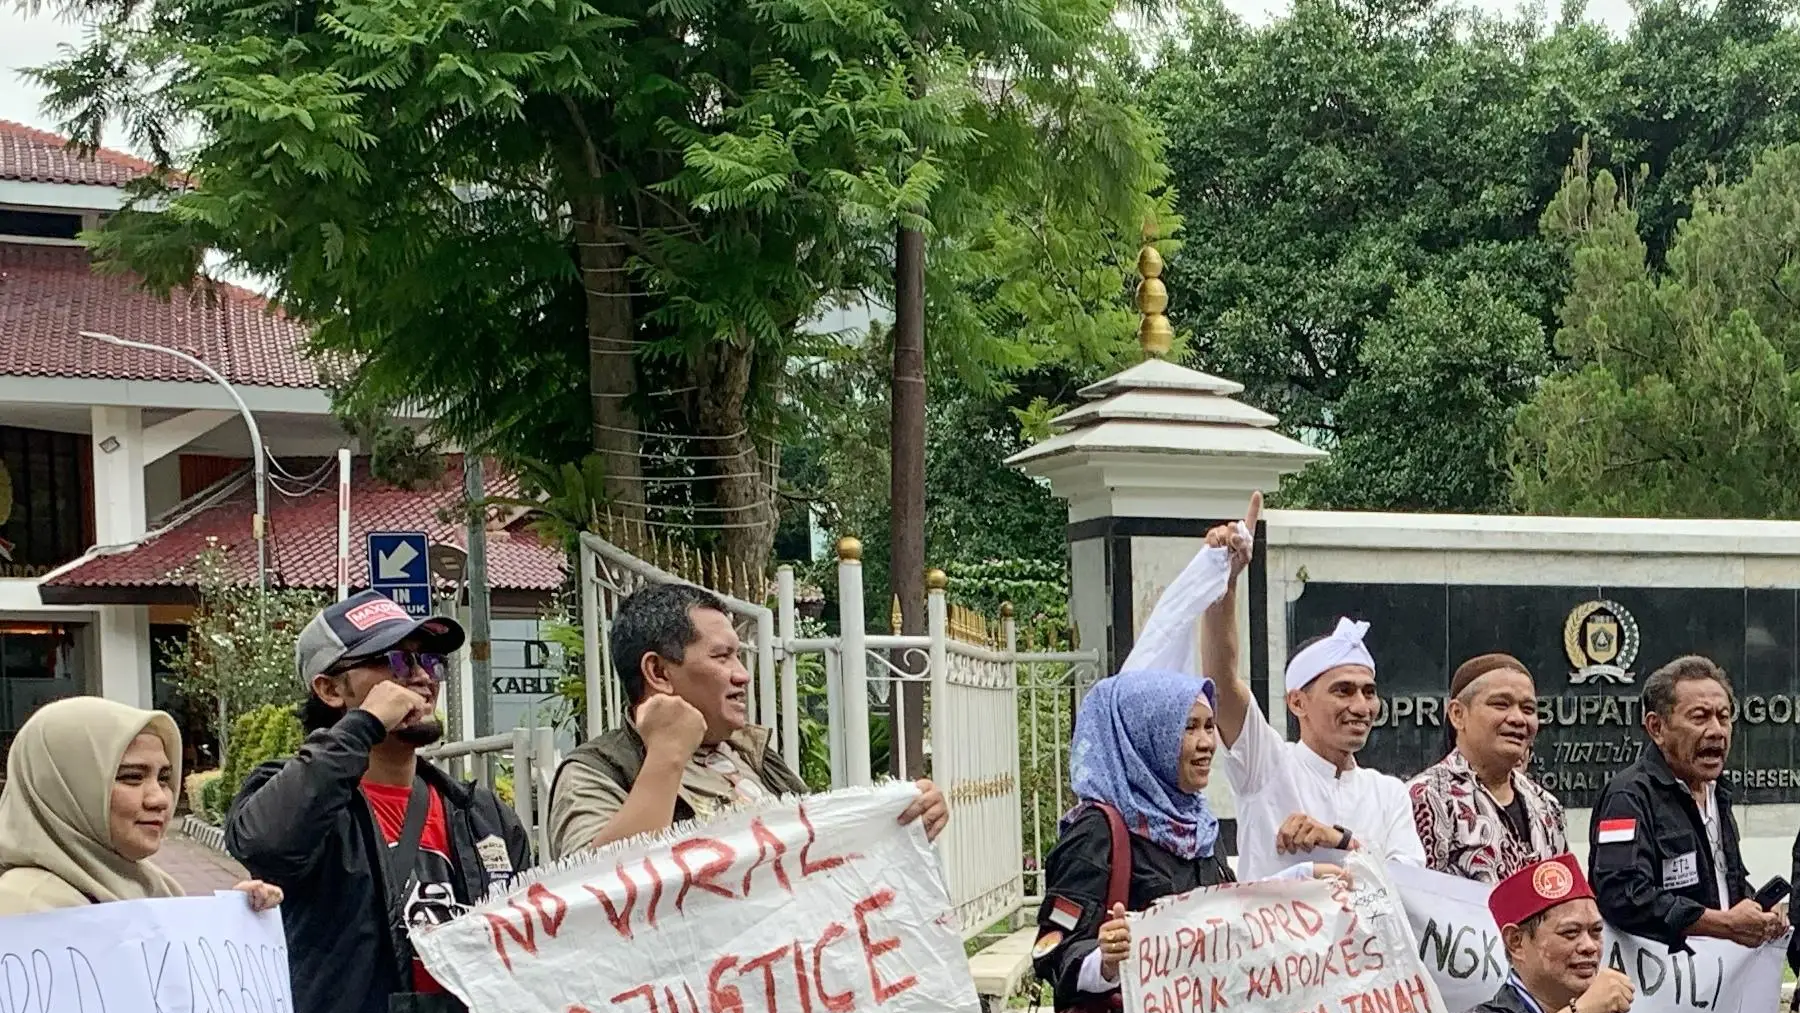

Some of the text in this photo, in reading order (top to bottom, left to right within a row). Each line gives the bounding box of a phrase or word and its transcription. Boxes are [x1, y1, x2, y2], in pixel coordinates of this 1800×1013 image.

[393, 588, 410, 604] IN
[484, 800, 864, 973] NO VIRAL
